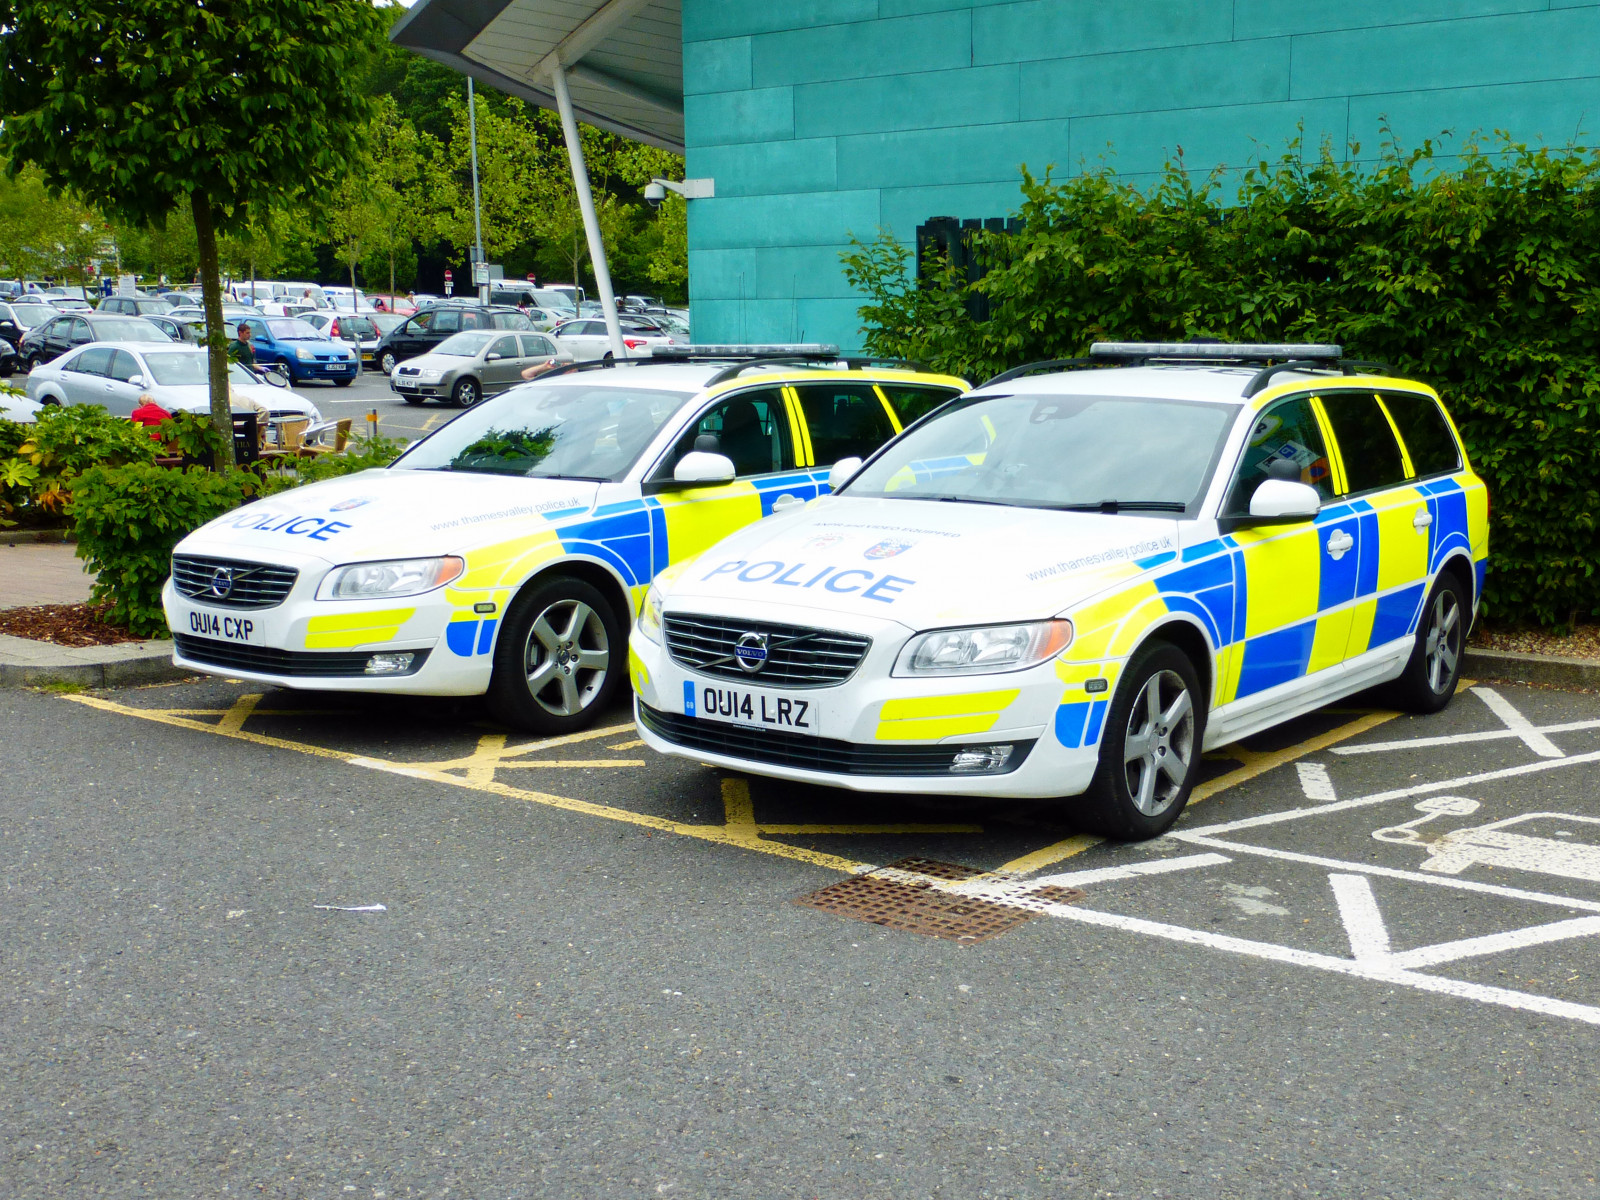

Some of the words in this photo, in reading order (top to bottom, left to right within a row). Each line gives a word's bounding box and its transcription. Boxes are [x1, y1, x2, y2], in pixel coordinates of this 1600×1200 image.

[209, 513, 353, 542] POLICE
[1026, 536, 1173, 582] www.thamesvalley.policeuk
[701, 559, 916, 604] POLICE
[190, 611, 220, 636] OU14
[224, 617, 253, 640] CXP
[736, 647, 764, 657] VOLVO
[704, 687, 754, 720] OU14
[761, 695, 809, 728] LRZ
